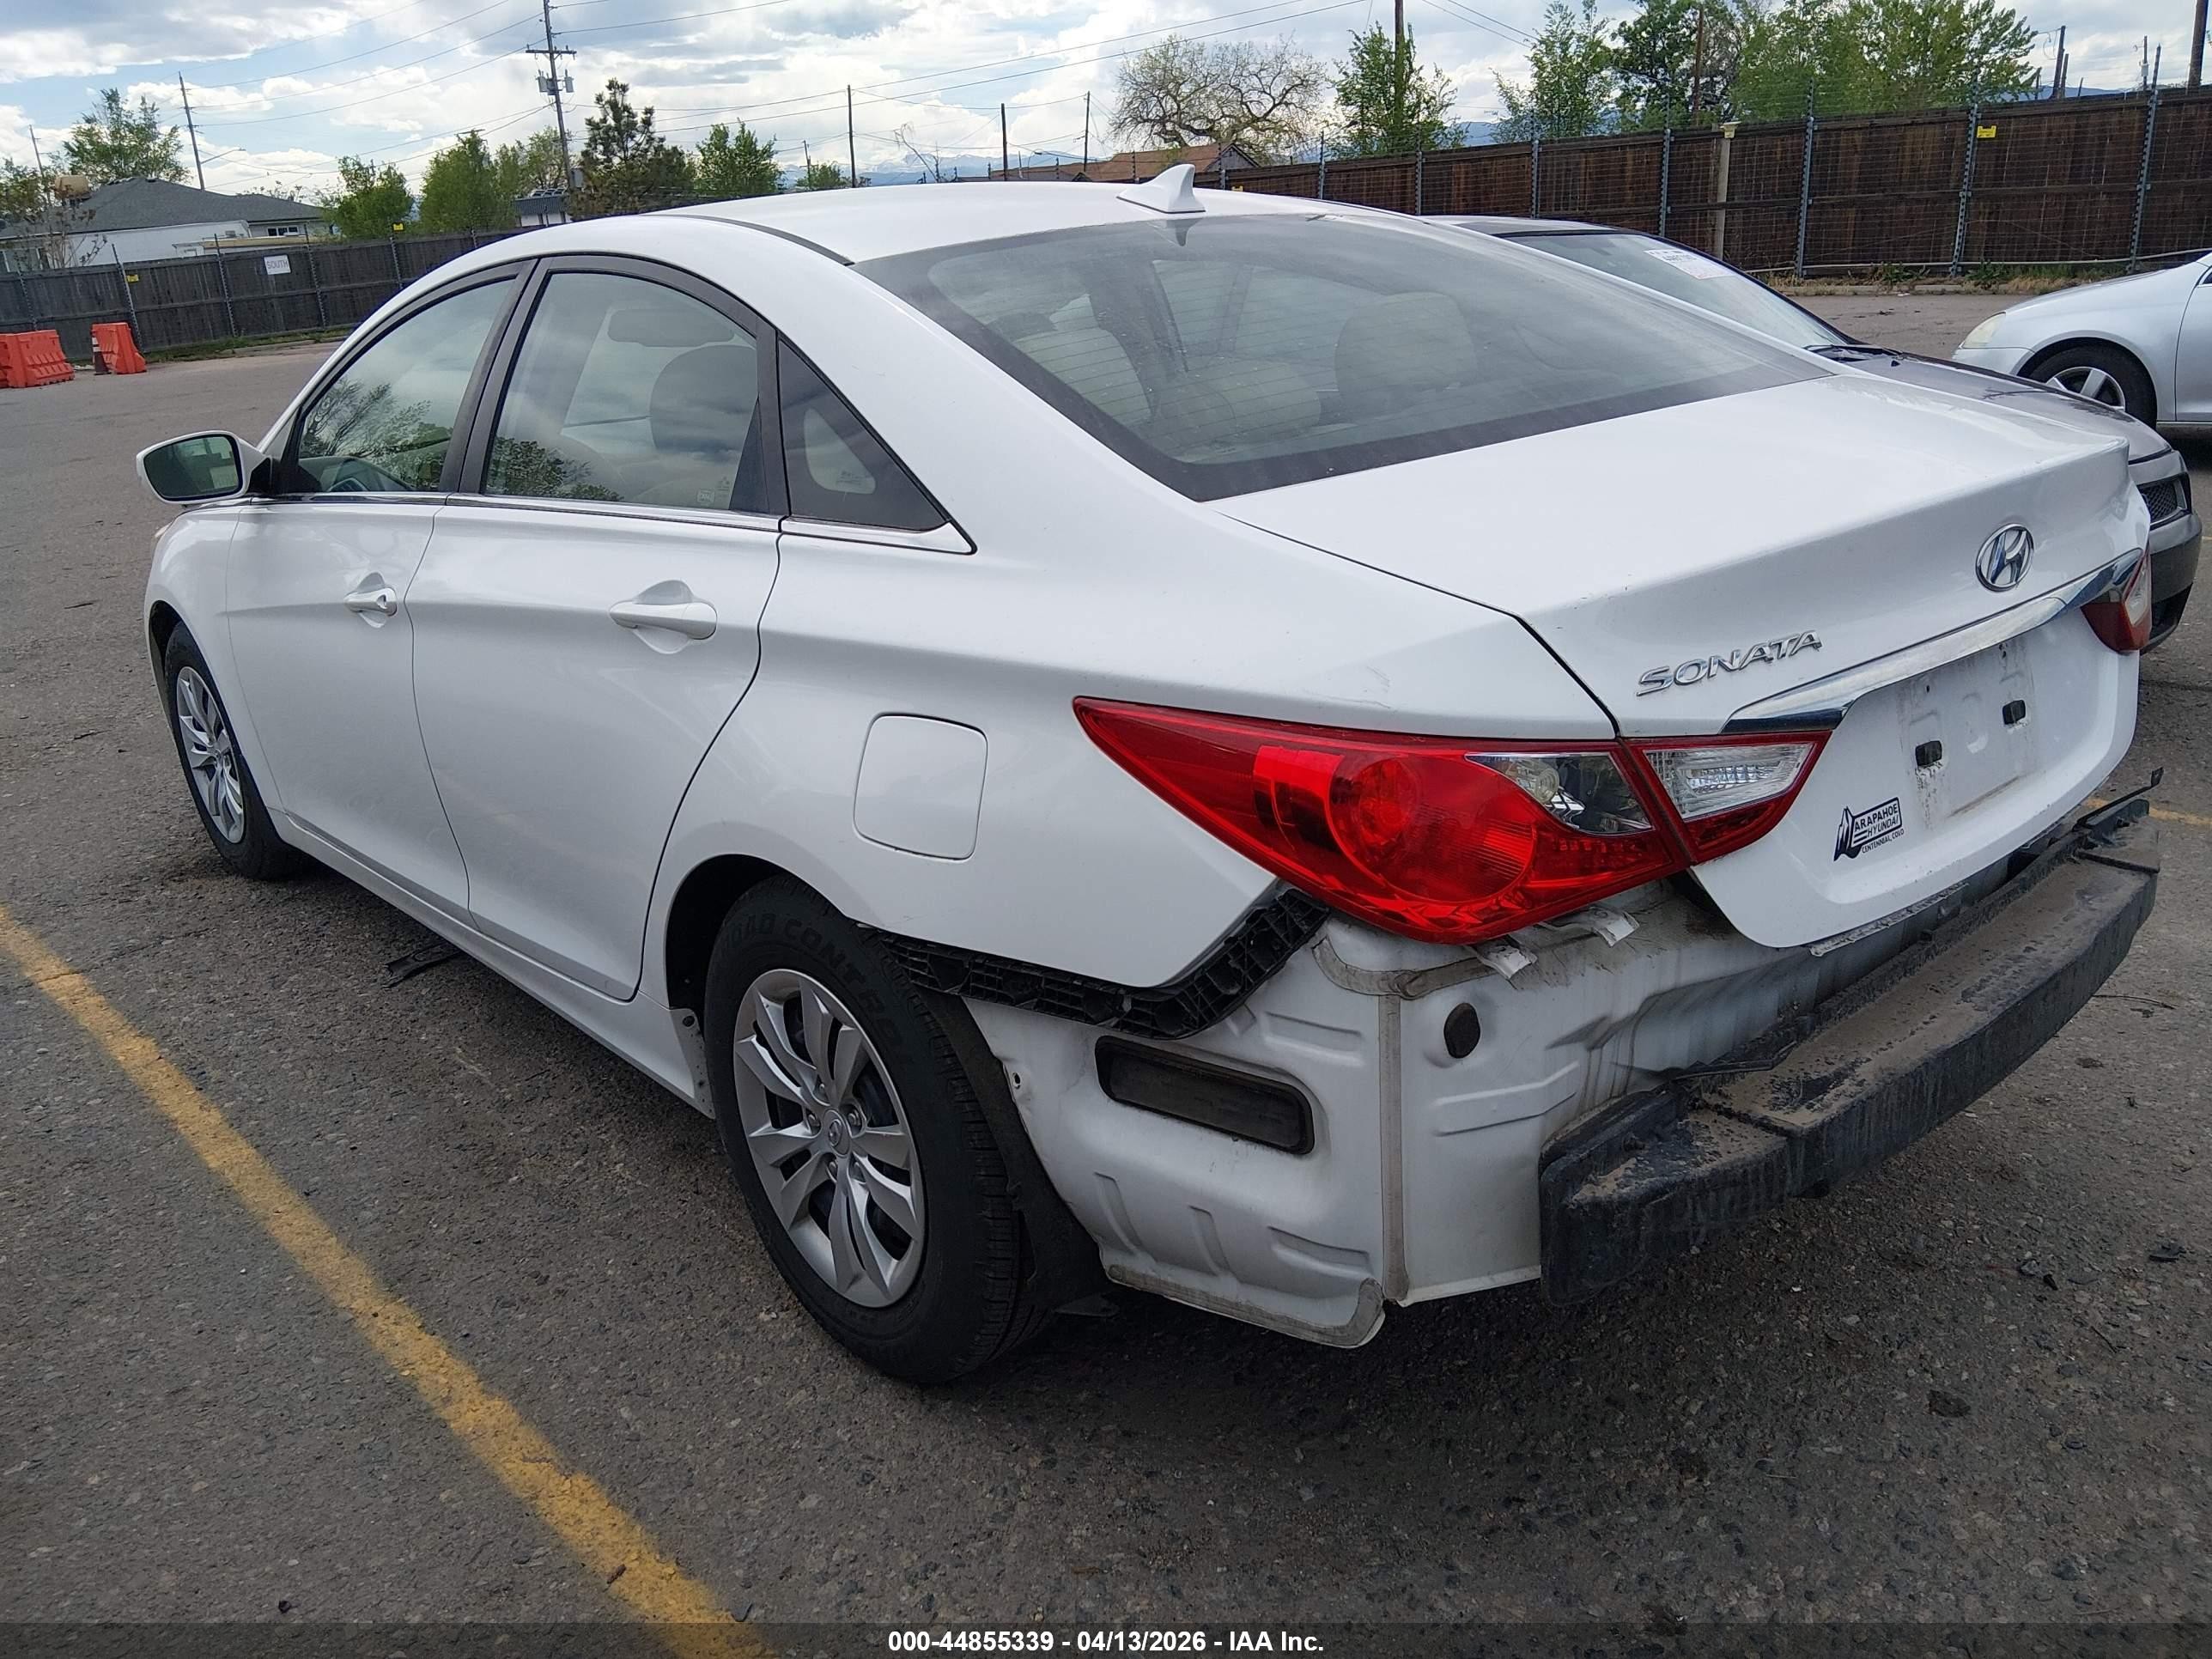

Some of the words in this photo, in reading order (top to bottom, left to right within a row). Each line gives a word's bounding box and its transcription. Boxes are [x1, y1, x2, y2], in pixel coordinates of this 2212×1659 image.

[266, 260, 289, 269] SOUTH
[1636, 629, 1823, 696] SONATA
[1855, 804, 1898, 831] ARAPAHOE
[1868, 815, 1899, 836] HYUNDAI
